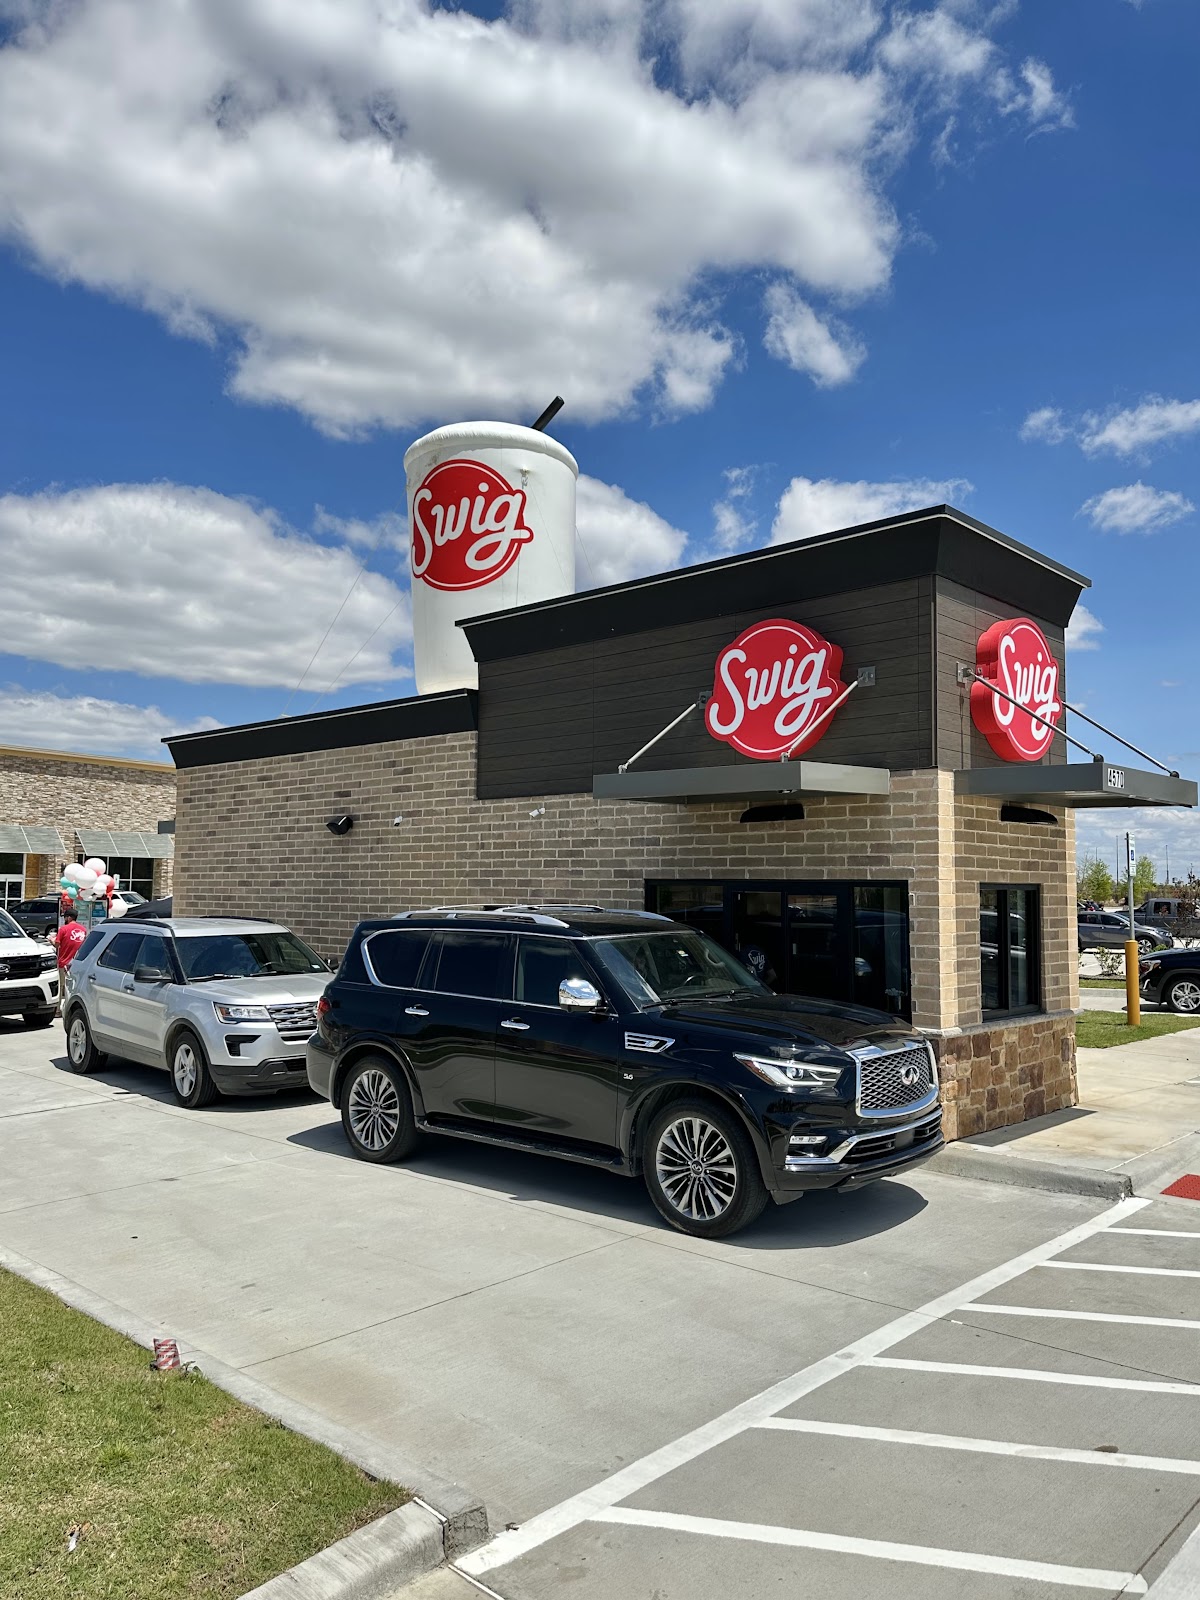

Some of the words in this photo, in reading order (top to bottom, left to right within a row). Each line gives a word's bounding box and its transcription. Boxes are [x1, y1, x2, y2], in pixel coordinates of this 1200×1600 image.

[412, 482, 530, 576] Swig
[709, 644, 832, 737] Swig
[994, 635, 1060, 741] Swig
[1108, 769, 1124, 788] 4570
